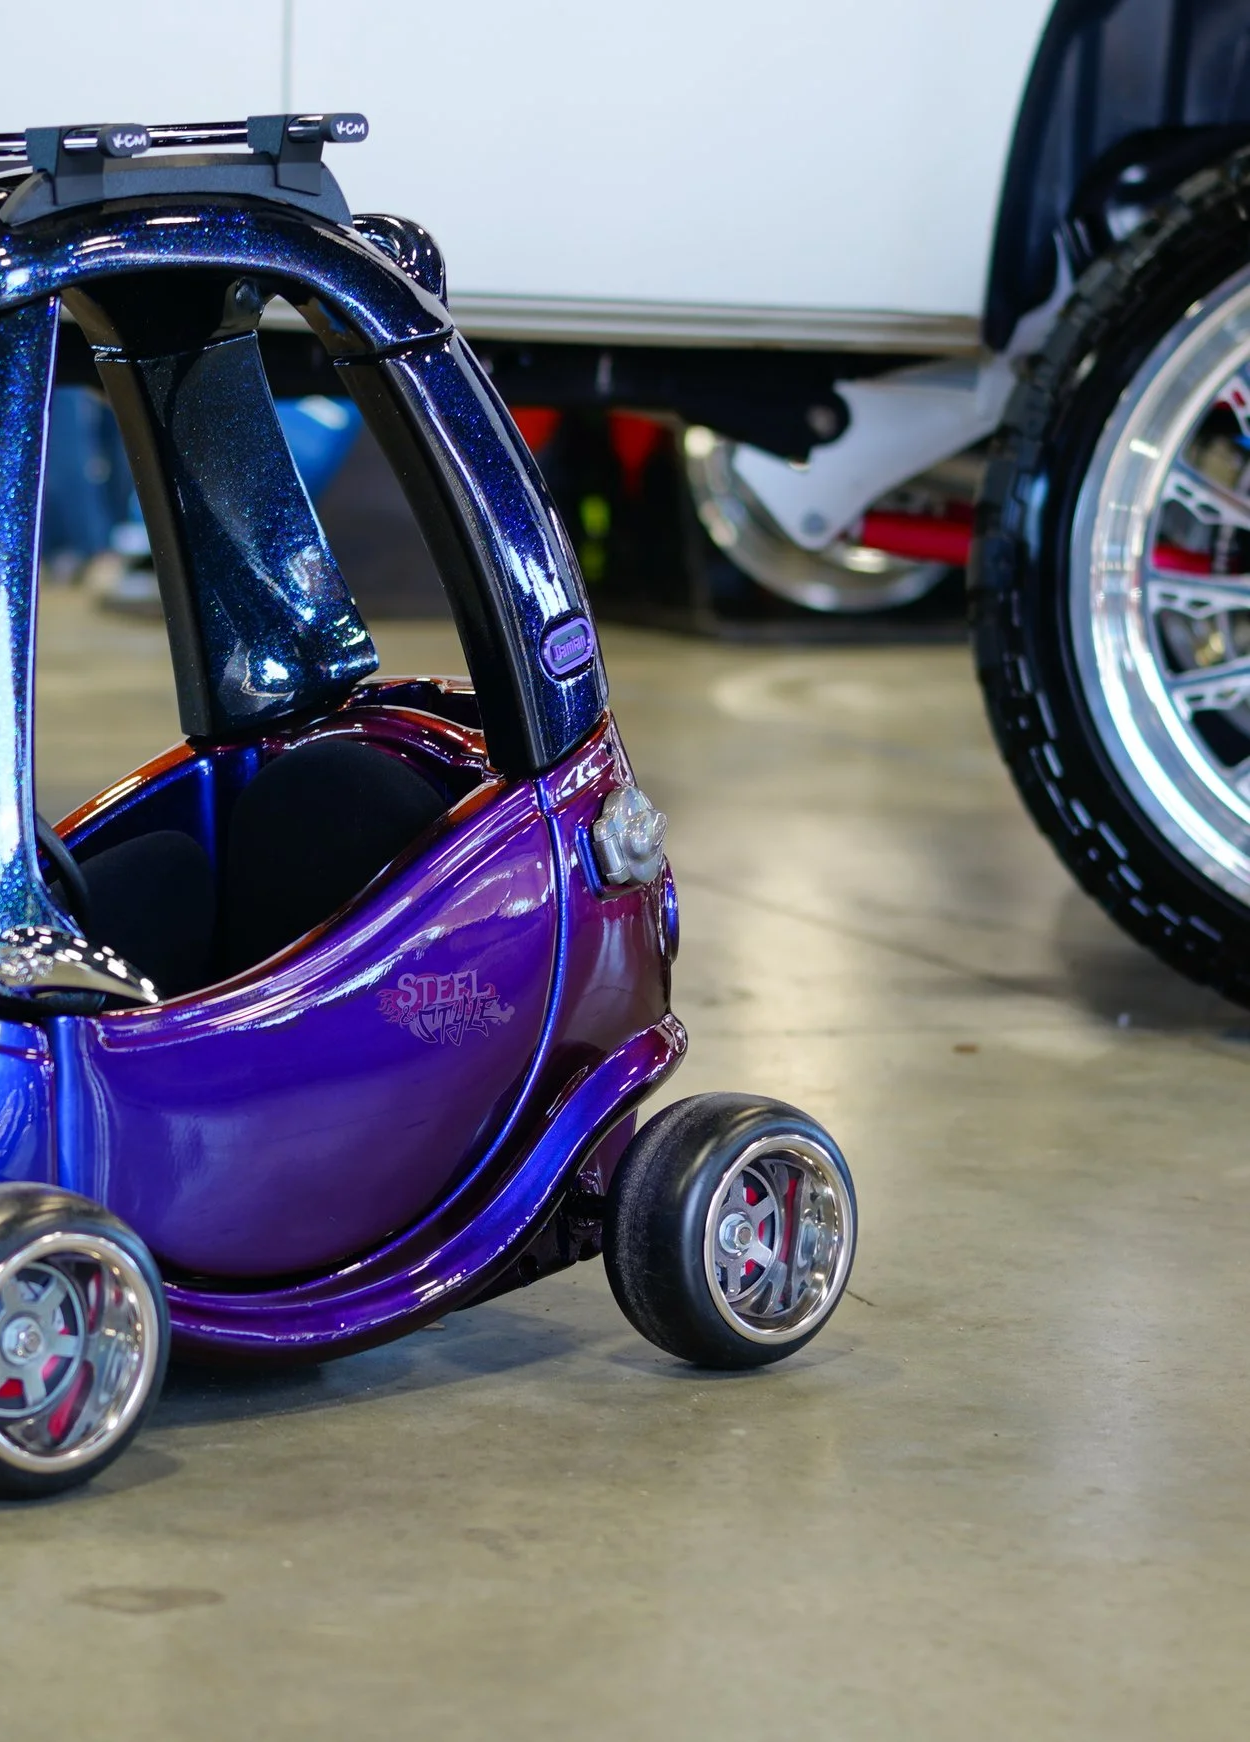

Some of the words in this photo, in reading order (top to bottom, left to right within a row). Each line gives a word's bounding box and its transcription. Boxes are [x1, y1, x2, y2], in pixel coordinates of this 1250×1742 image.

[551, 634, 587, 662] Damian
[396, 969, 494, 1009] STEEL
[401, 1004, 415, 1024] &
[416, 994, 501, 1046] STYLE
